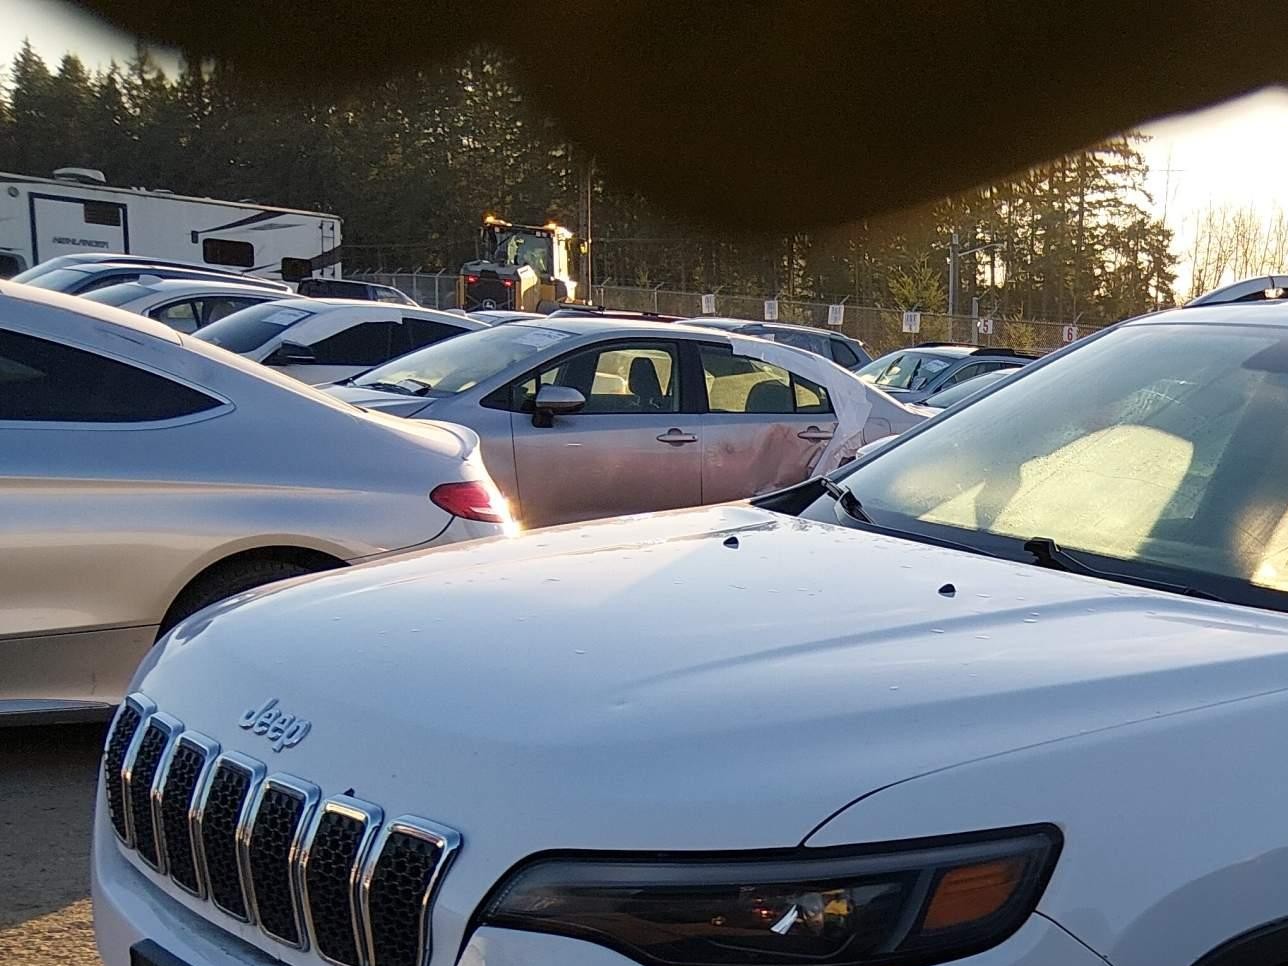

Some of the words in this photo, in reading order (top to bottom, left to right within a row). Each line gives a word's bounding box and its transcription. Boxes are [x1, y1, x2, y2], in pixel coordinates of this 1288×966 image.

[982, 319, 988, 333] 5
[1066, 327, 1073, 341] 6
[239, 698, 312, 753] Jeep
